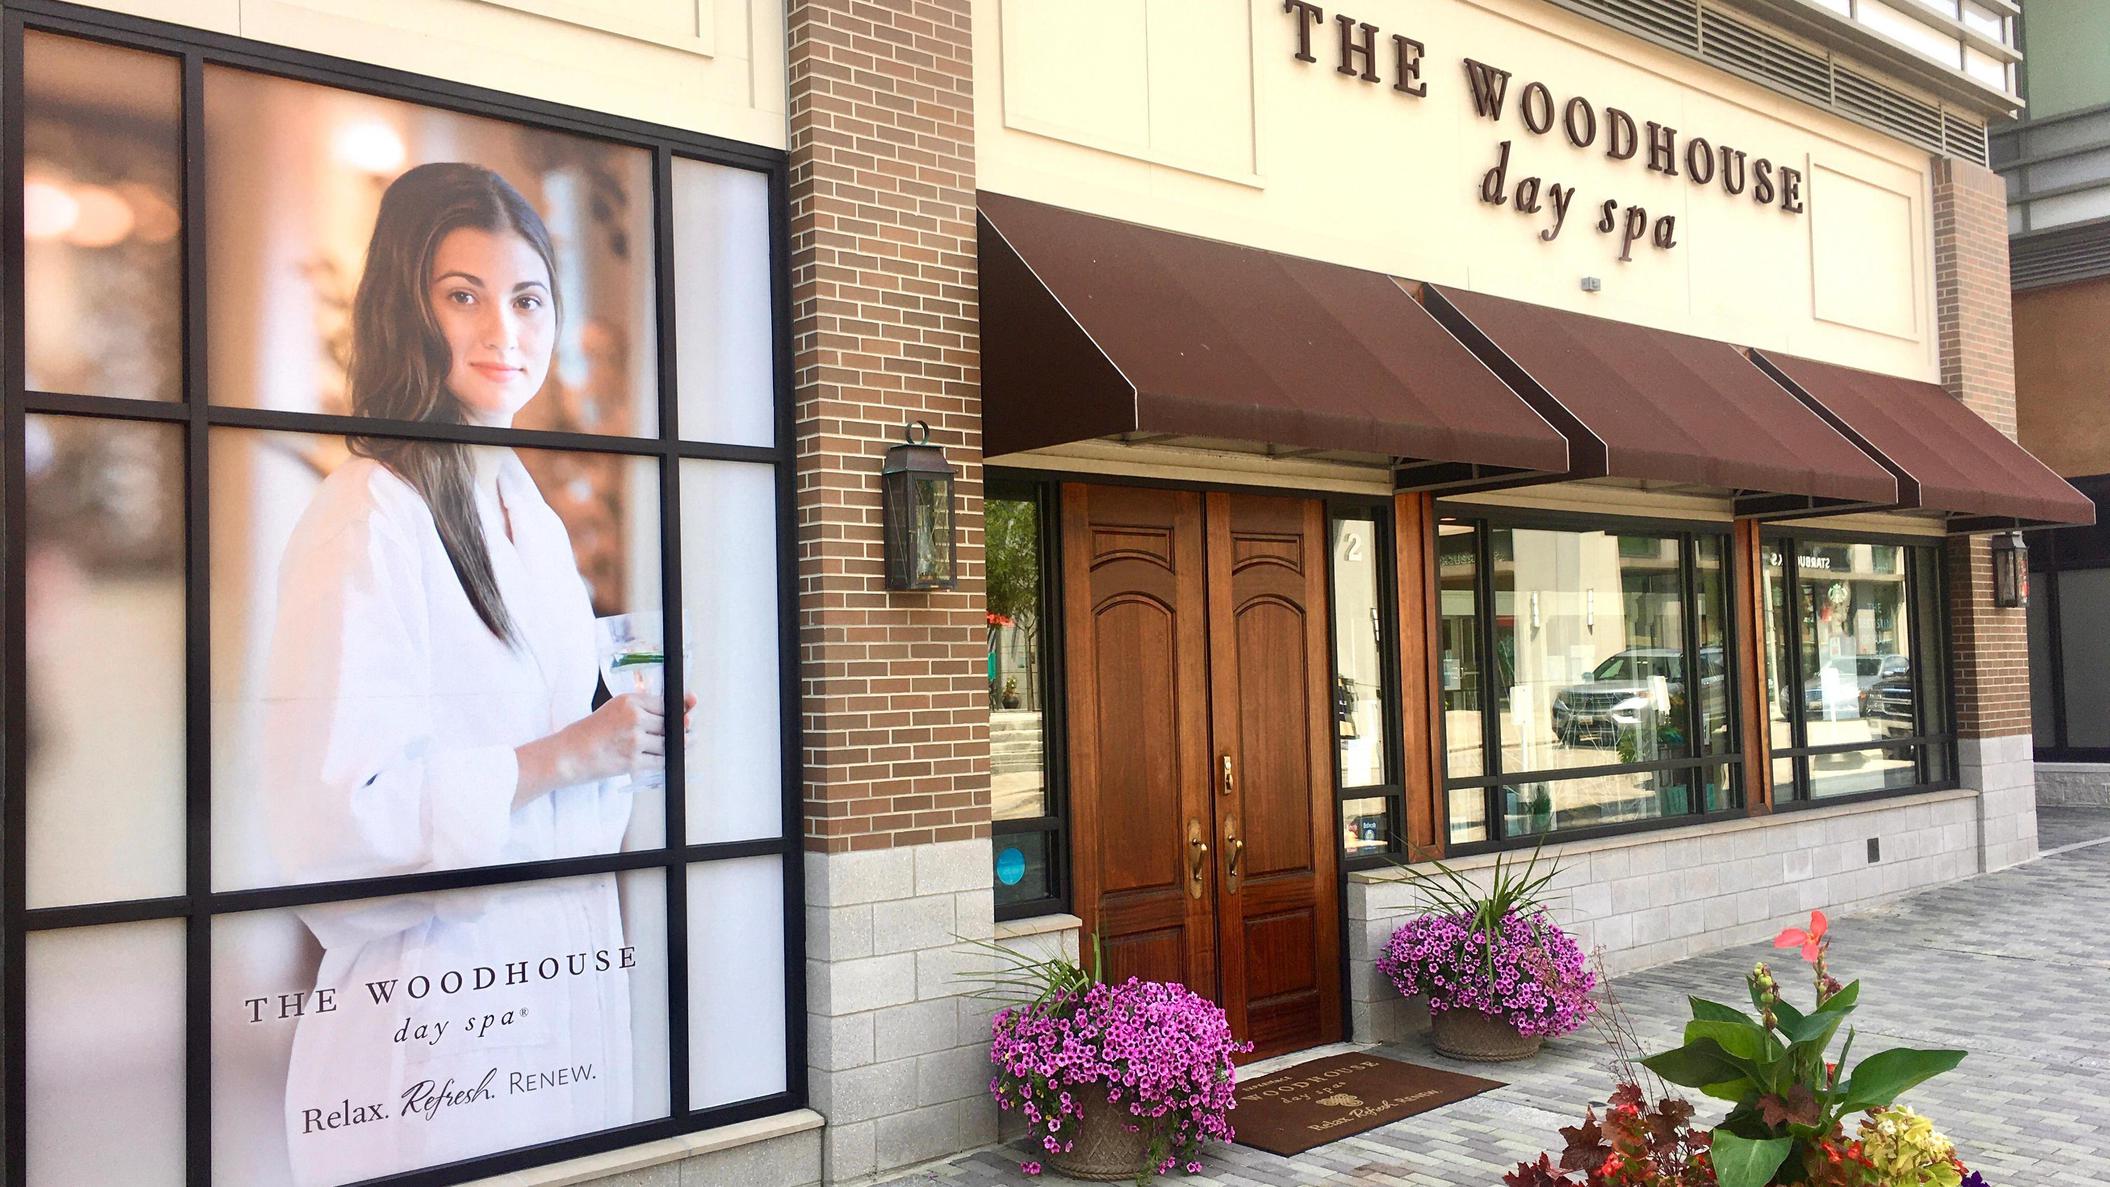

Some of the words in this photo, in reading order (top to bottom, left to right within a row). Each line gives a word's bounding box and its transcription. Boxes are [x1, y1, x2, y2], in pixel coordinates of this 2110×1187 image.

[1285, 0, 1427, 98] THE
[1463, 57, 1804, 214] WOODHOUSE
[1478, 140, 1575, 242] day
[1597, 198, 1678, 262] spa
[1344, 533, 1362, 561] 2
[245, 988, 338, 1024] THE
[365, 946, 637, 1006] WOODHOUSE
[394, 1017, 449, 1046] day
[301, 1100, 390, 1134] Relax.
[400, 1067, 496, 1122] Refresh.
[509, 1063, 597, 1096] RENEW.
[1240, 1061, 1379, 1101] WOODHOUSE
[1281, 1093, 1311, 1104] day
